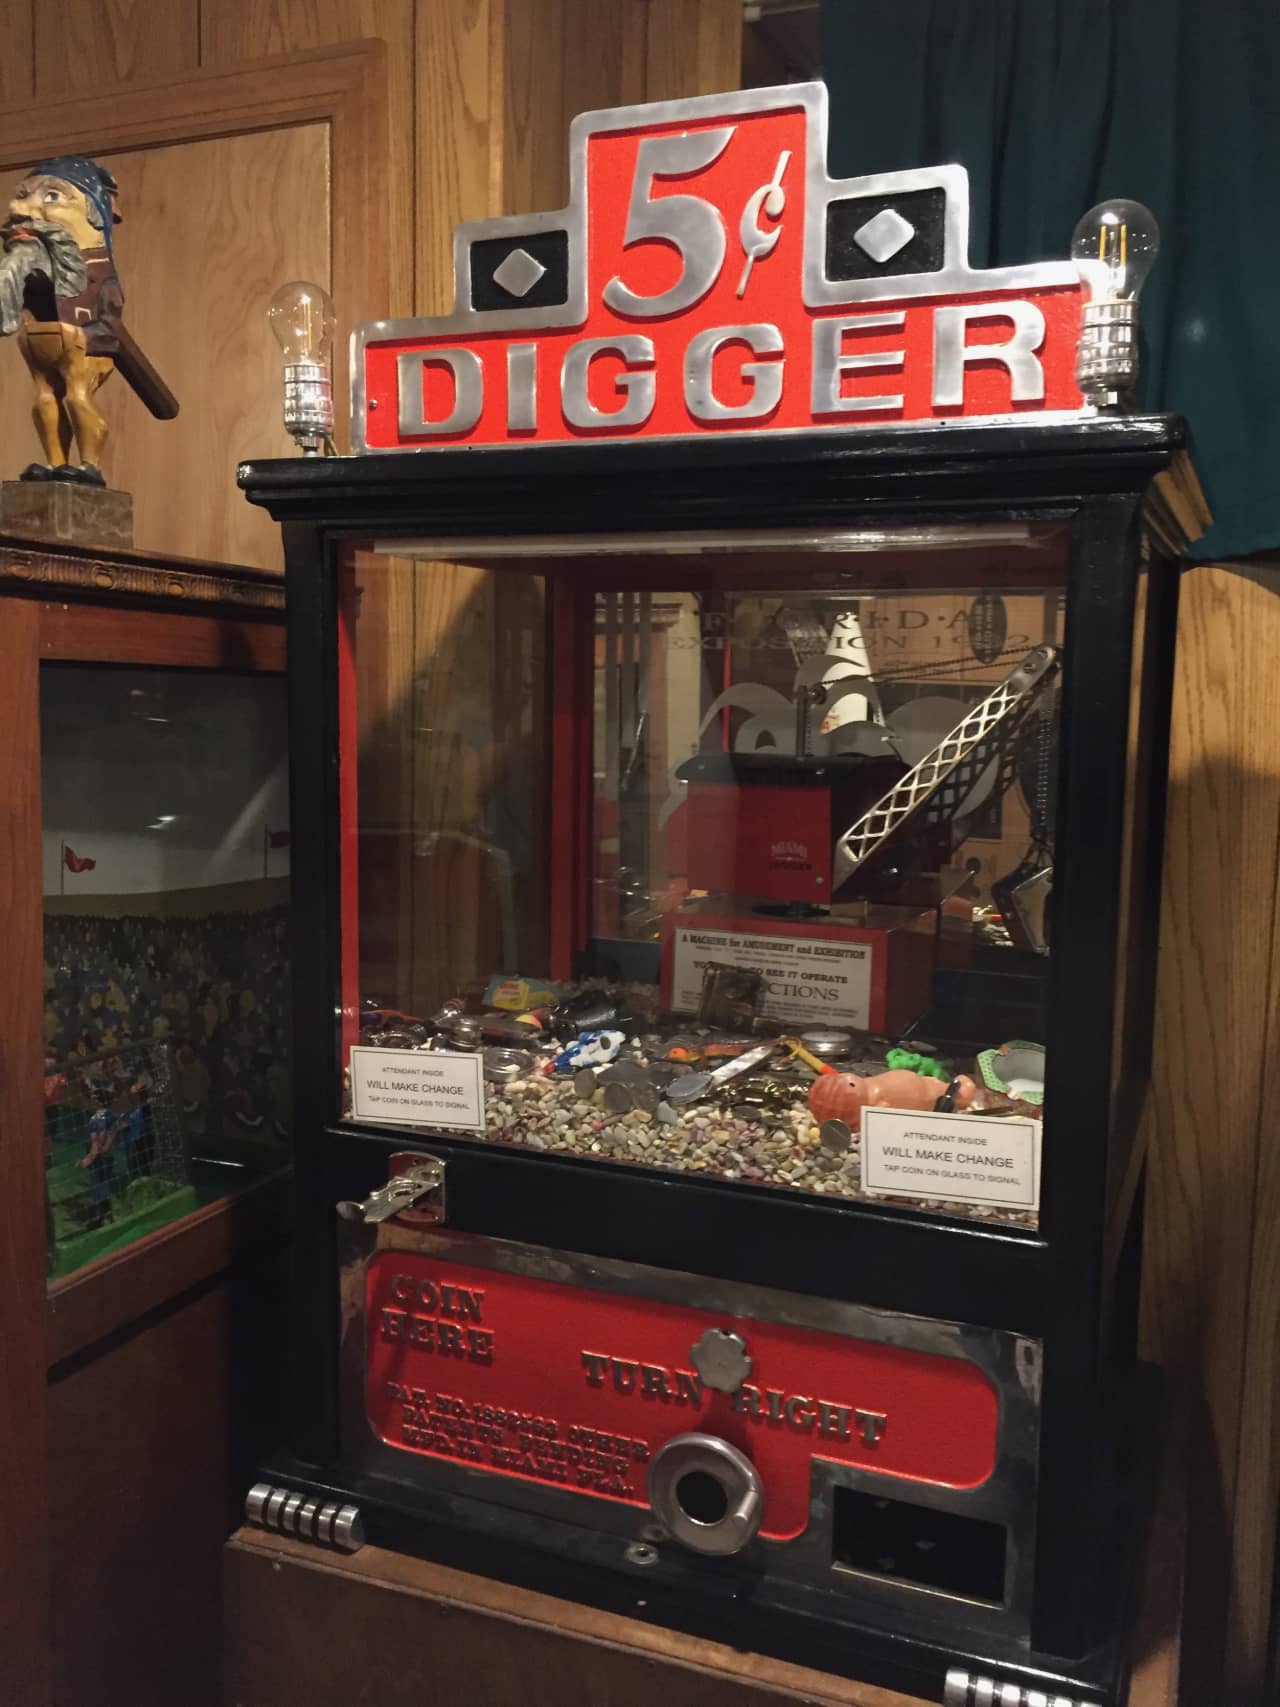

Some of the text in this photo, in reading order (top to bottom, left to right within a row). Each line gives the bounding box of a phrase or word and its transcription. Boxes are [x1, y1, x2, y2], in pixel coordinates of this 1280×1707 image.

[602, 125, 792, 317] 5¢
[398, 300, 1046, 437] DIGGER
[682, 934, 688, 943] A
[690, 935, 727, 947] MACHINE
[729, 938, 740, 947] for
[742, 939, 794, 953] AMUSEMENT
[797, 945, 811, 955] and
[814, 946, 866, 960] EXHIBITION
[766, 968, 785, 978] SEE
[788, 970, 798, 979] IT
[801, 971, 848, 984] OPERATE
[382, 1066, 444, 1077] ATTENDANT INSIDE
[367, 1079, 465, 1096] WILL MAKE CHANGE
[368, 1095, 470, 1110] TAP COIN ON GLASS TO SIGNAL
[903, 1131, 988, 1147] ATTENDANT INSIDE
[882, 1145, 1015, 1169] WILL MAKE CHANGE
[884, 1164, 1022, 1186] TAP COIN ON GLASS TO SIGNAL
[391, 1274, 485, 1323] COIN
[381, 1307, 495, 1362] HERE
[581, 1350, 887, 1443] TURN RIGHT
